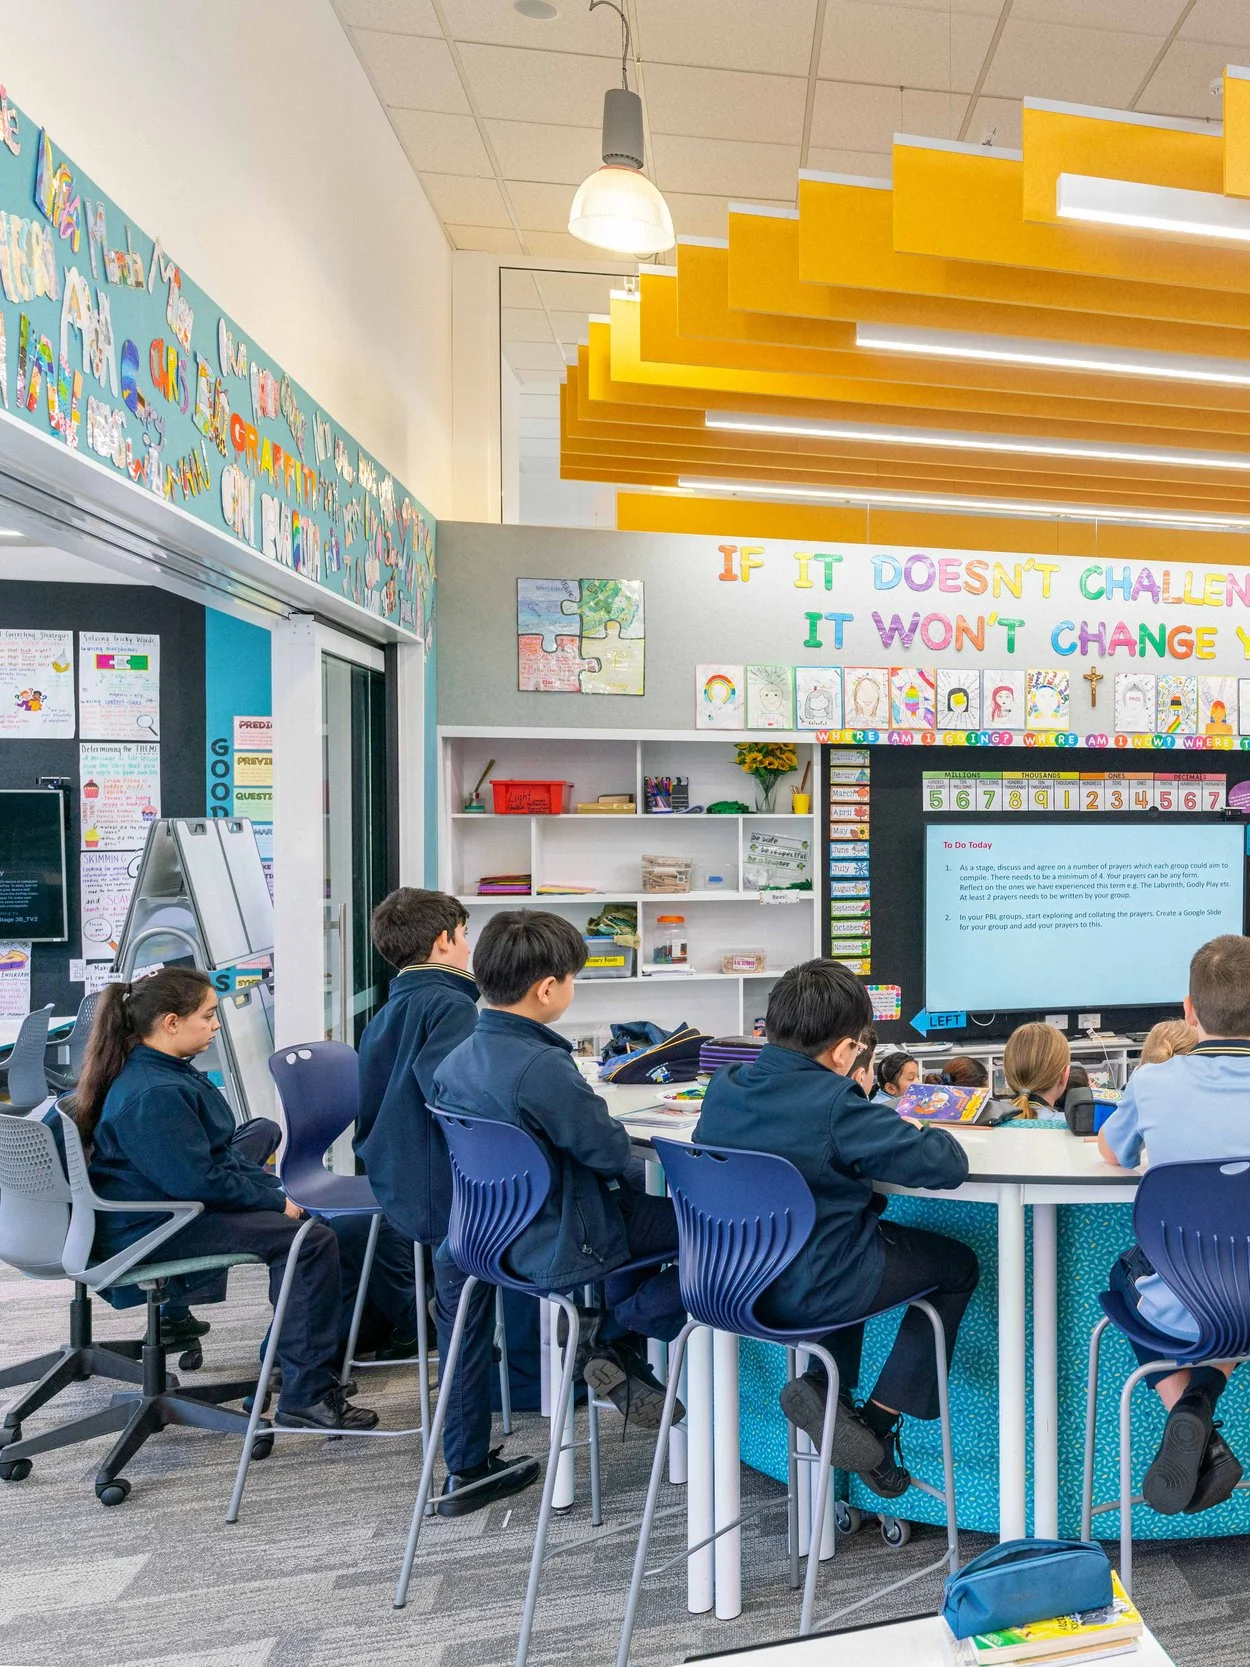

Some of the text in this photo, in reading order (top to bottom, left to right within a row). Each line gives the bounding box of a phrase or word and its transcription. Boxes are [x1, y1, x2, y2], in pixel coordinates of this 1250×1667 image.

[230, 412, 317, 512] GRAFFITI
[718, 544, 766, 583] IF
[793, 551, 844, 590] IT
[870, 553, 1061, 598] DOESN'T
[803, 611, 854, 650] IT
[872, 611, 1026, 654] WON'T
[1050, 620, 1218, 660] CHANGE
[817, 730, 876, 742] WHERE
[891, 732, 913, 743] AM
[946, 732, 1010, 743] GOING?
[1025, 734, 1075, 745] WHERE
[1088, 735, 1105, 746] AM
[1134, 736, 1172, 747] NOW?
[1184, 737, 1230, 748] WHERE
[135, 744, 159, 753] THEME
[832, 789, 855, 797] March
[930, 790, 943, 809] 5
[956, 790, 970, 809] 6
[983, 790, 996, 809] 7
[1009, 790, 1022, 809] 8
[1035, 790, 1048, 809] 9
[1064, 789, 1070, 809] 1
[1086, 791, 1098, 809] 2
[1111, 791, 1123, 809] 3
[1135, 791, 1148, 809] 4
[1160, 791, 1172, 809] 5
[1184, 791, 1197, 809] 6
[1209, 791, 1220, 809] 7
[832, 808, 852, 817] April
[832, 827, 848, 836] May
[943, 841, 992, 849] To Do Today
[83, 854, 126, 864] SKIMMING
[1055, 883, 1095, 891] experienced
[1153, 881, 1185, 889] Labyrinth,
[929, 1014, 961, 1027] LEFT
